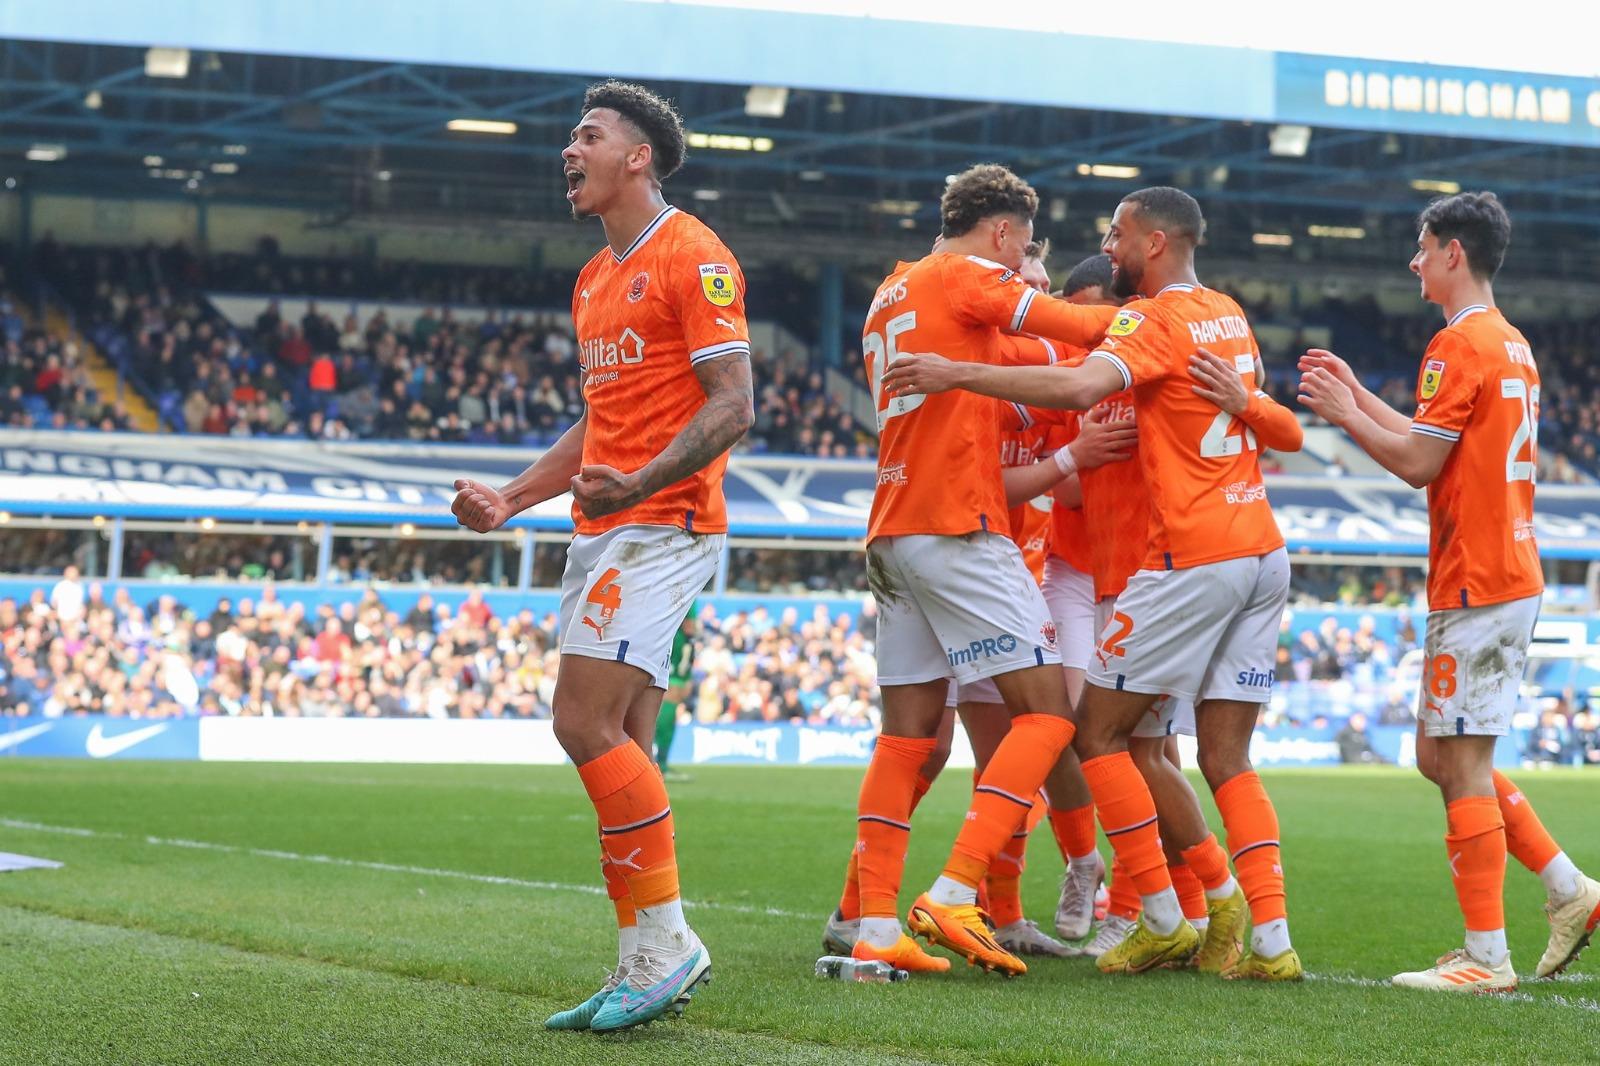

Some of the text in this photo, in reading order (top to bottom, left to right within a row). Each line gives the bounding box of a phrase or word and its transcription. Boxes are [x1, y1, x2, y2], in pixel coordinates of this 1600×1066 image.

[1324, 69, 1571, 124] BIRMINGHAM
[701, 266, 714, 274] sky
[584, 337, 618, 370] ilita
[595, 371, 619, 387] power
[3, 451, 289, 494] NGHAM
[586, 568, 621, 619] 4
[947, 634, 1017, 666] imPRO
